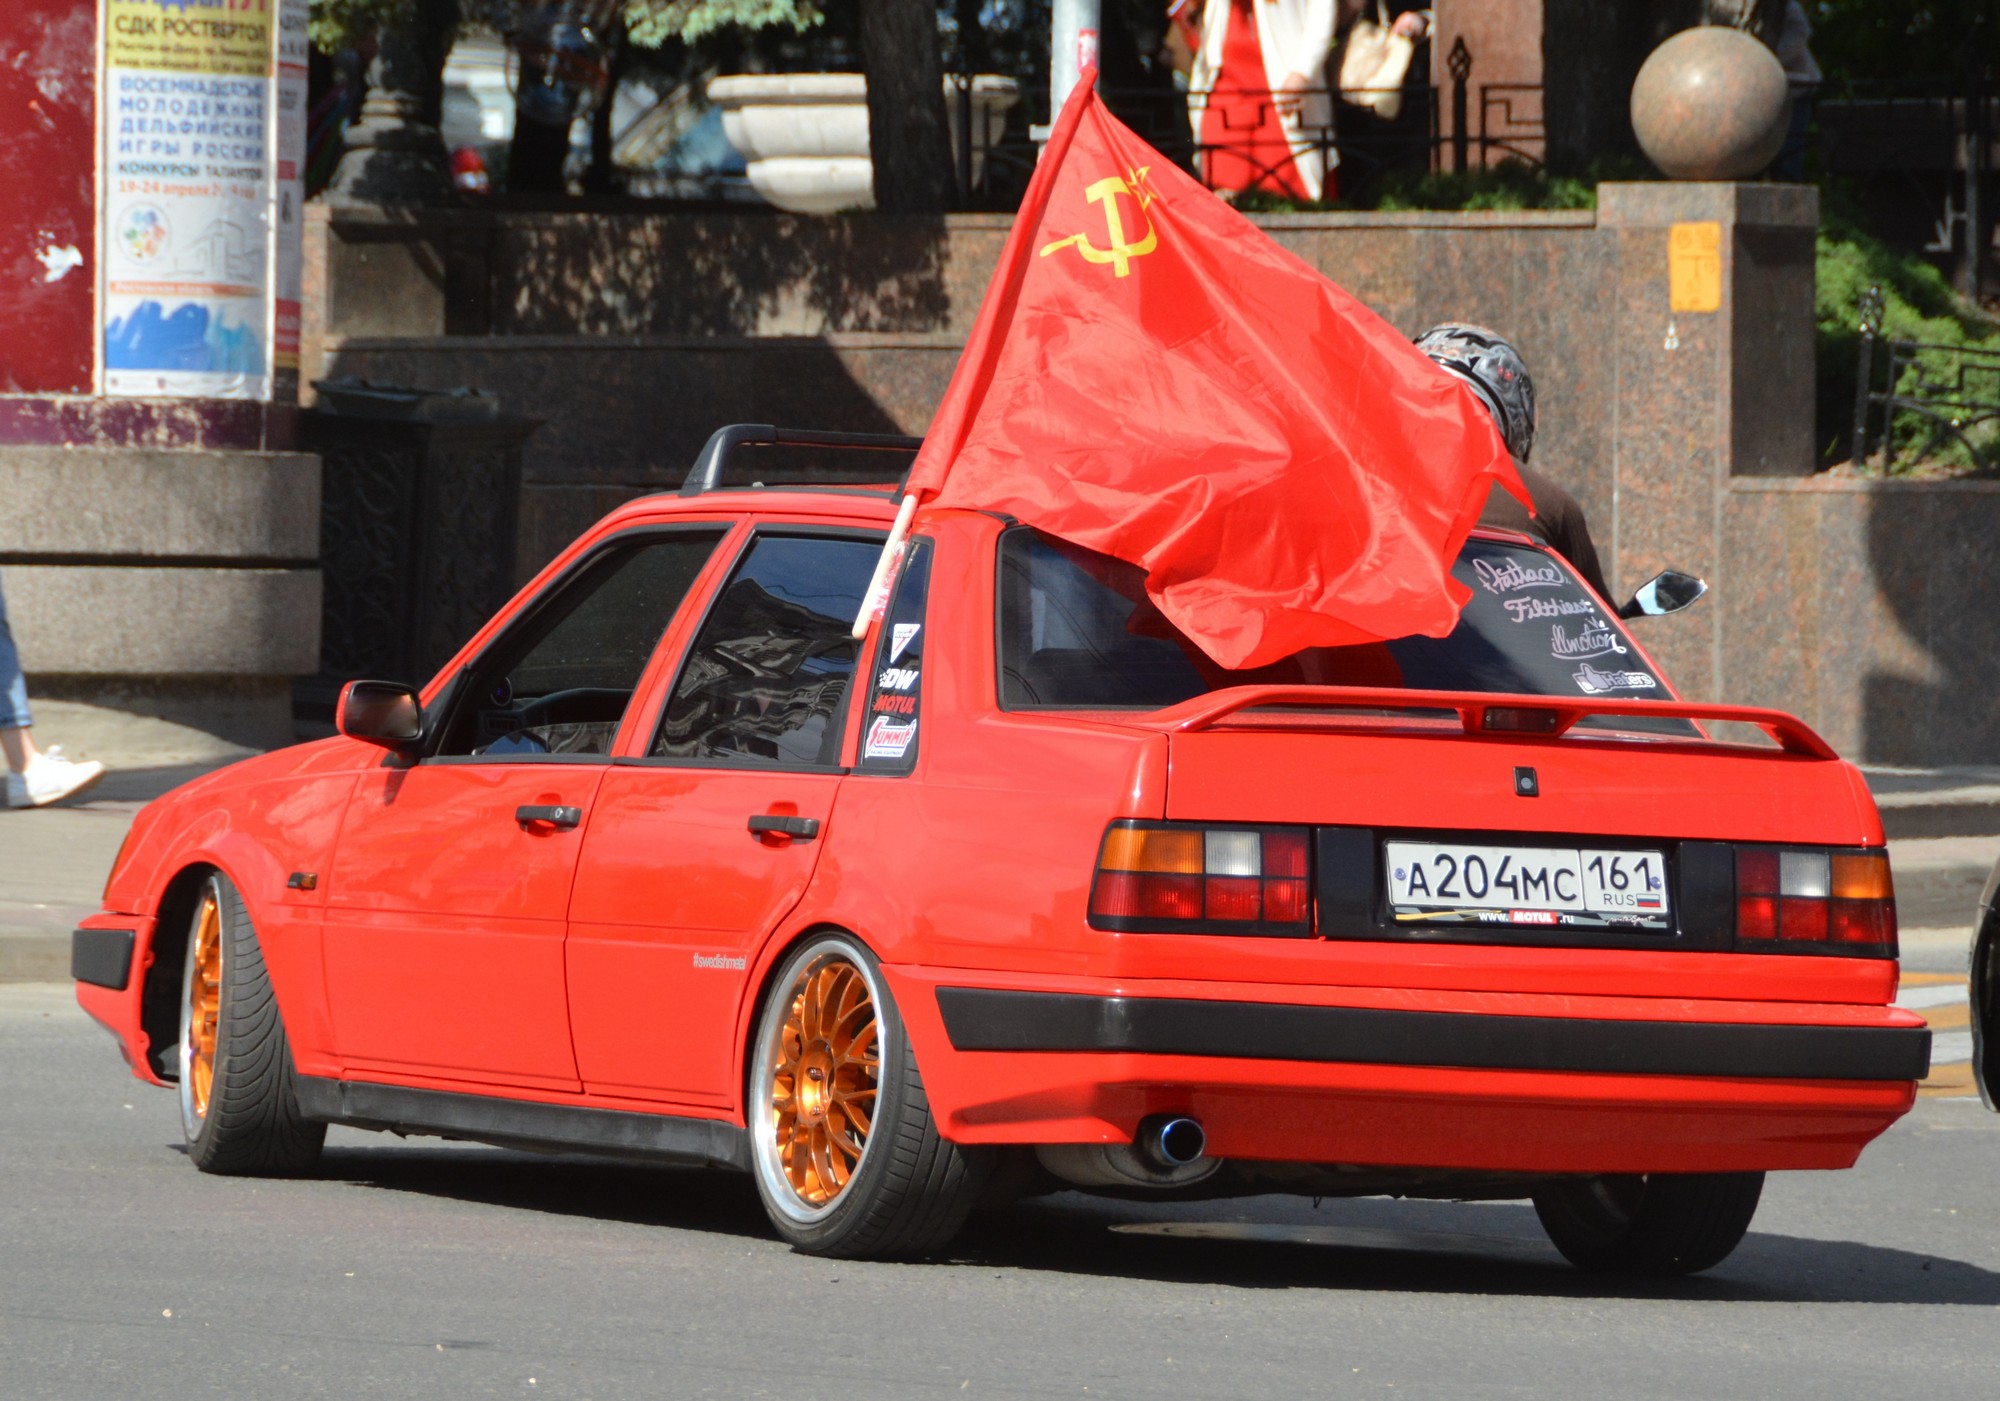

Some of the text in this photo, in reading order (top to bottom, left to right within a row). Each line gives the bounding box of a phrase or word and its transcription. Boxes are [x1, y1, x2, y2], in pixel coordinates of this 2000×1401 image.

[115, 15, 158, 36] СДК
[162, 17, 267, 42] РОСТВЕРТОЛ
[119, 76, 263, 98] ВОСЕМНАДЦАТЫЕ
[119, 139, 263, 161] ИГРЫ РОССИИ
[118, 161, 200, 178] КОНКУРСЫ
[119, 180, 161, 194] 19-24
[884, 668, 919, 690] DW
[1600, 671, 1653, 687] Haters
[873, 694, 916, 715] MOTUL
[1587, 855, 1651, 892] 161
[1603, 893, 1636, 907] RUS
[1479, 911, 1575, 924] www. MOTUL .ru
